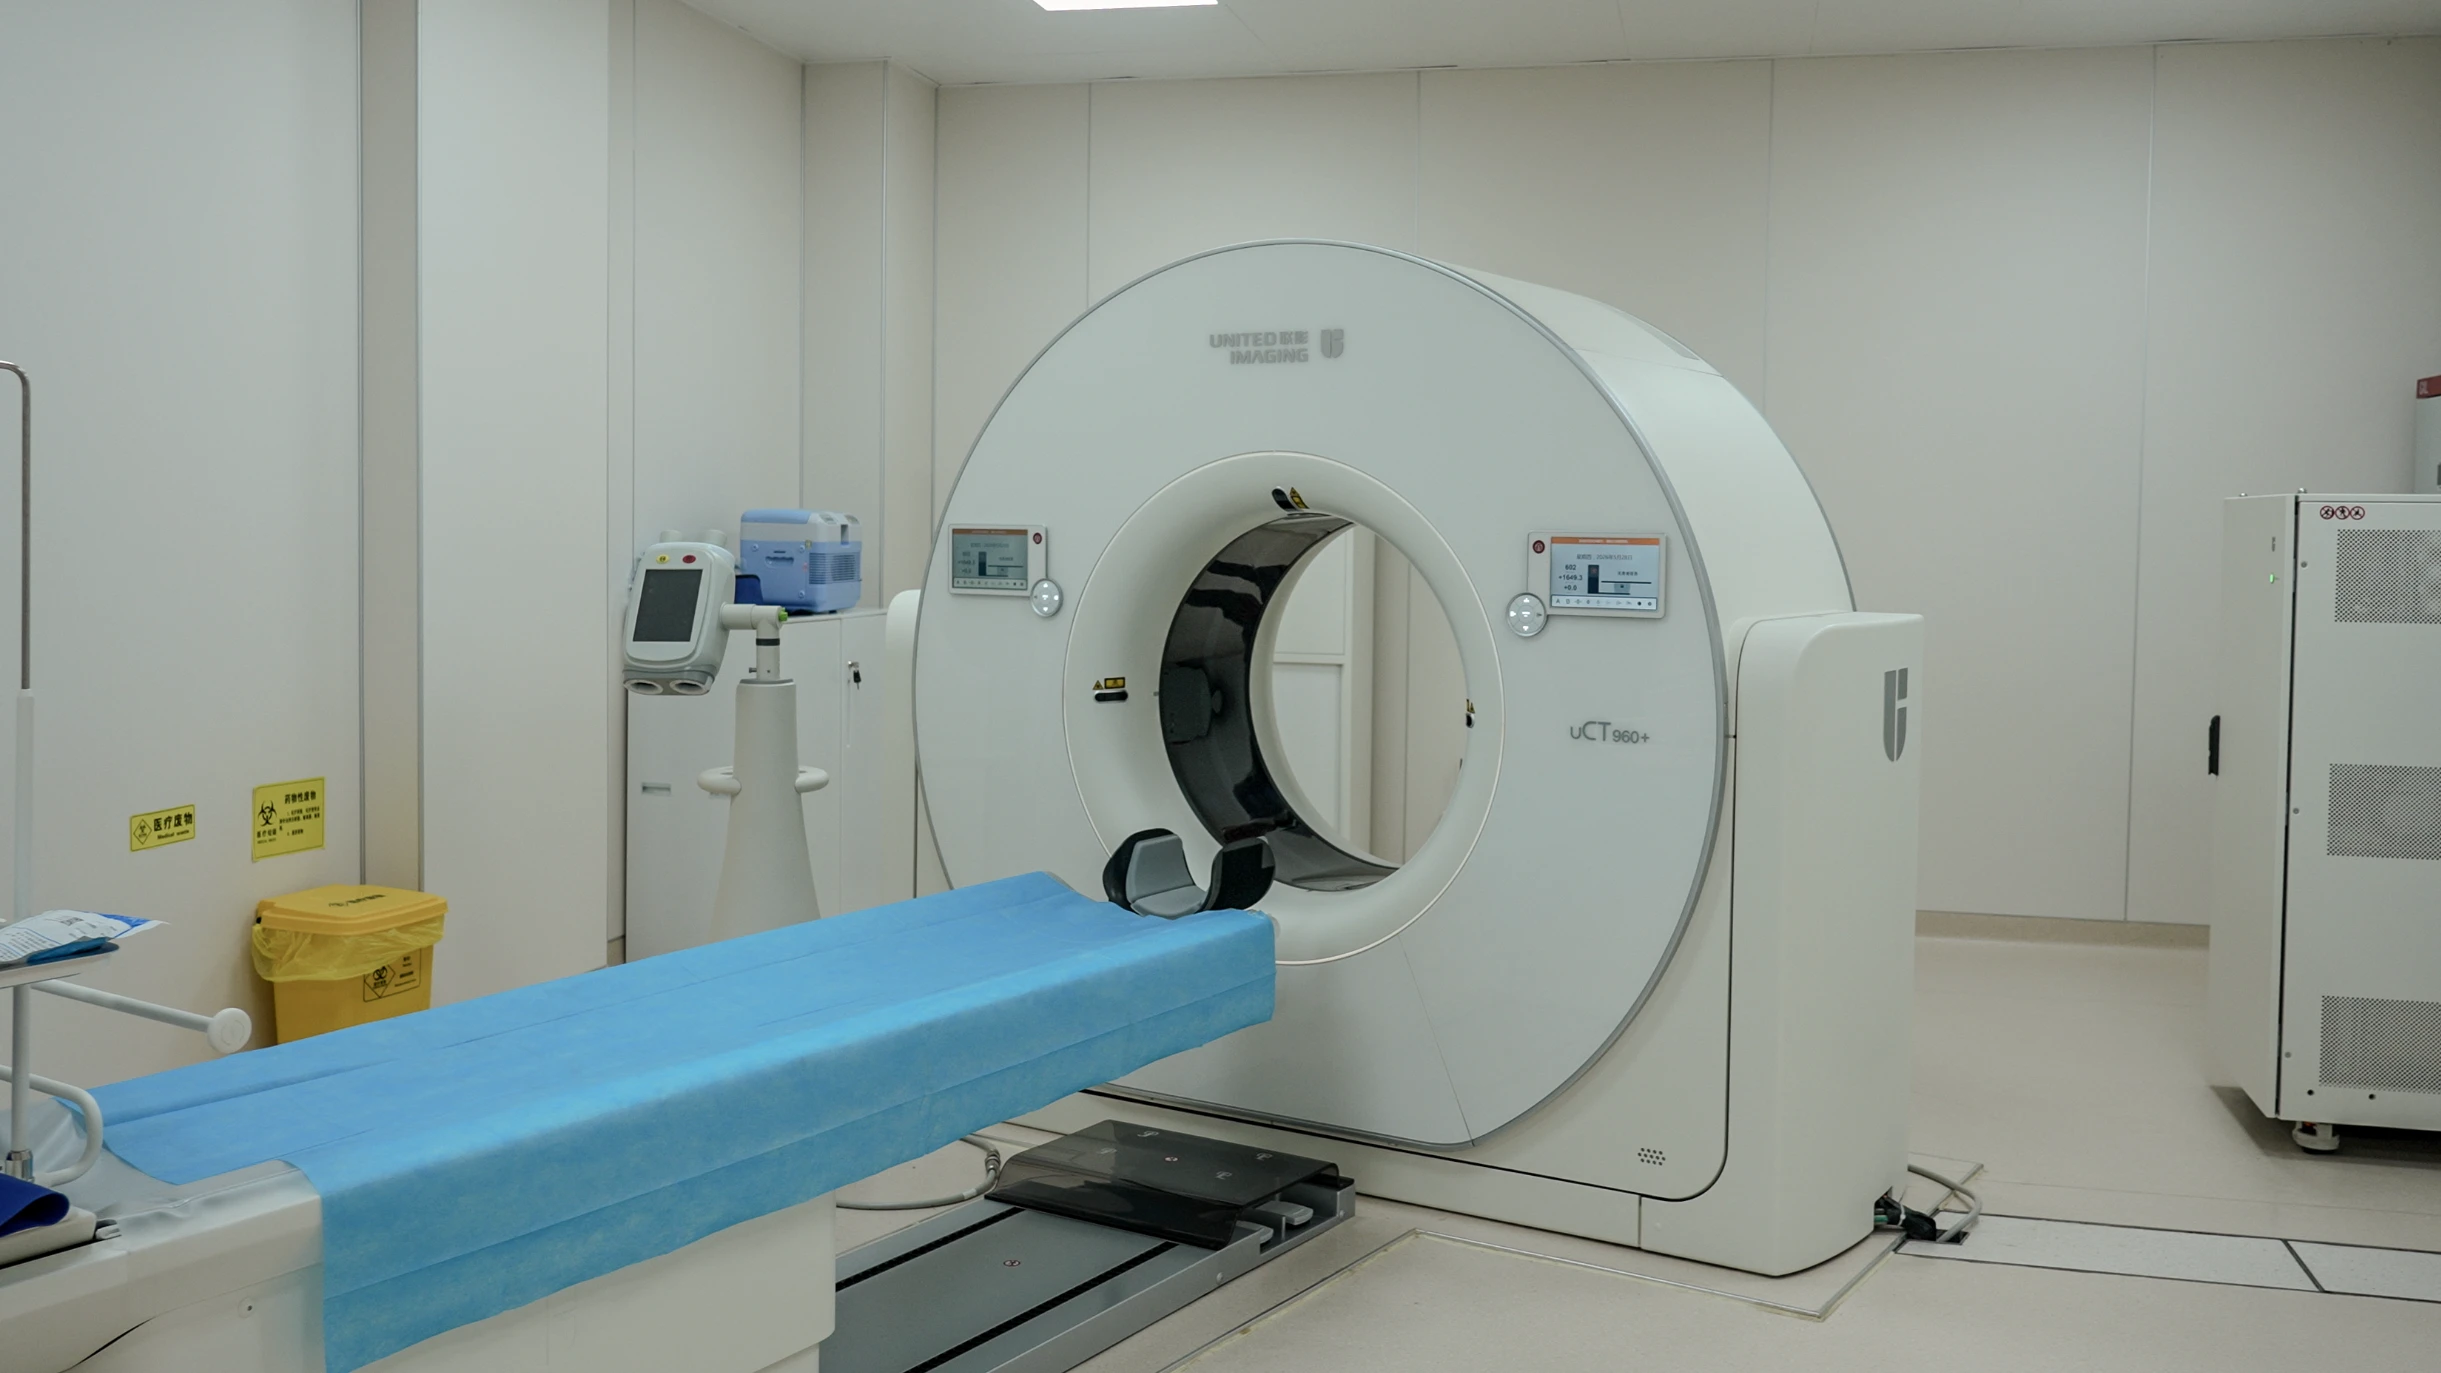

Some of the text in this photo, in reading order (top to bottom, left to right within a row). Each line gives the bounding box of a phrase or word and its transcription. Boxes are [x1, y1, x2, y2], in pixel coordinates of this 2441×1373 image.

[1209, 331, 1277, 348] UNITED
[1230, 348, 1309, 365] IMAGING
[1570, 721, 1650, 744] uCT 960+
[153, 812, 193, 831] 医疗废物
